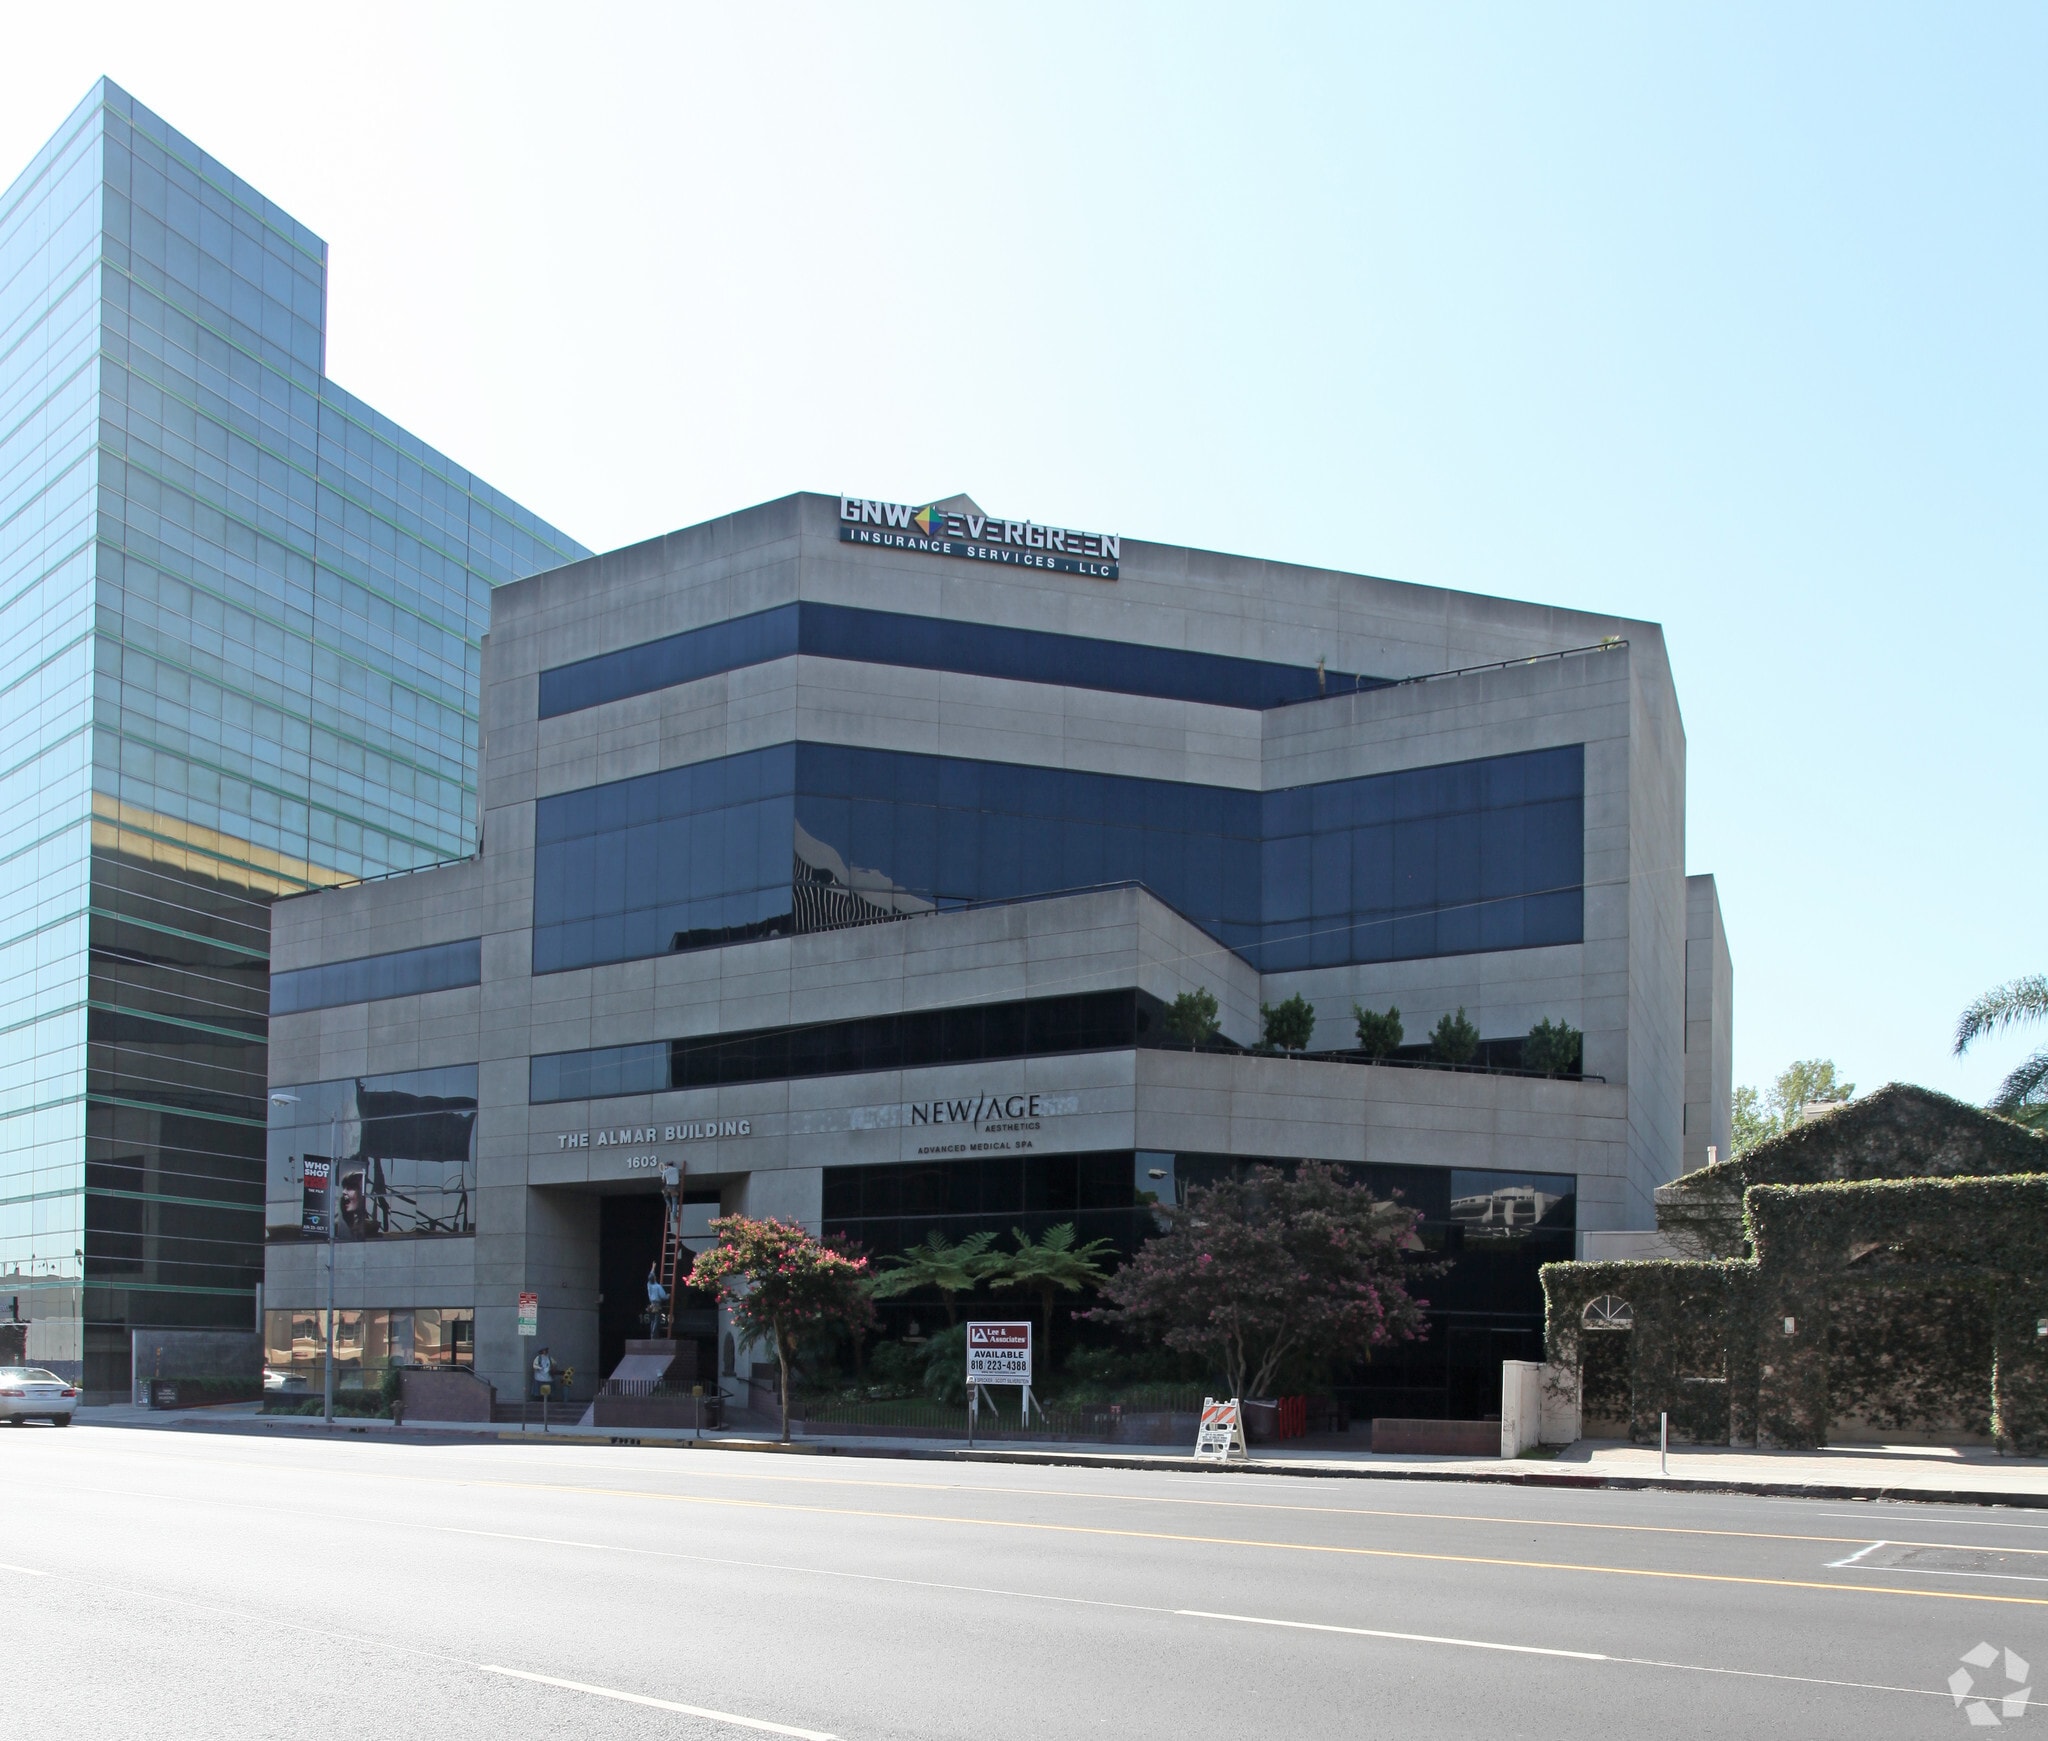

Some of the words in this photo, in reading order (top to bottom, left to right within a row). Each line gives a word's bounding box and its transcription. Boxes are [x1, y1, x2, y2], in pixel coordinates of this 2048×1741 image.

[840, 498, 913, 529] GNW
[947, 512, 1120, 559] EVERGREEN
[850, 529, 952, 554] INSURANCE
[1079, 562, 1110, 576] LLC
[911, 1099, 973, 1125] NEW
[985, 1095, 1041, 1120] AGE
[558, 1134, 590, 1149] THE
[597, 1127, 657, 1146] ALMAR
[665, 1119, 751, 1142] BUILDING
[985, 1122, 1041, 1132] AESTHETICS
[918, 1144, 966, 1154] ADVANCED
[970, 1142, 1011, 1151] MEDICAL
[1015, 1140, 1033, 1149] SPA
[304, 1161, 330, 1171] WHO
[304, 1169, 329, 1178] SHOT
